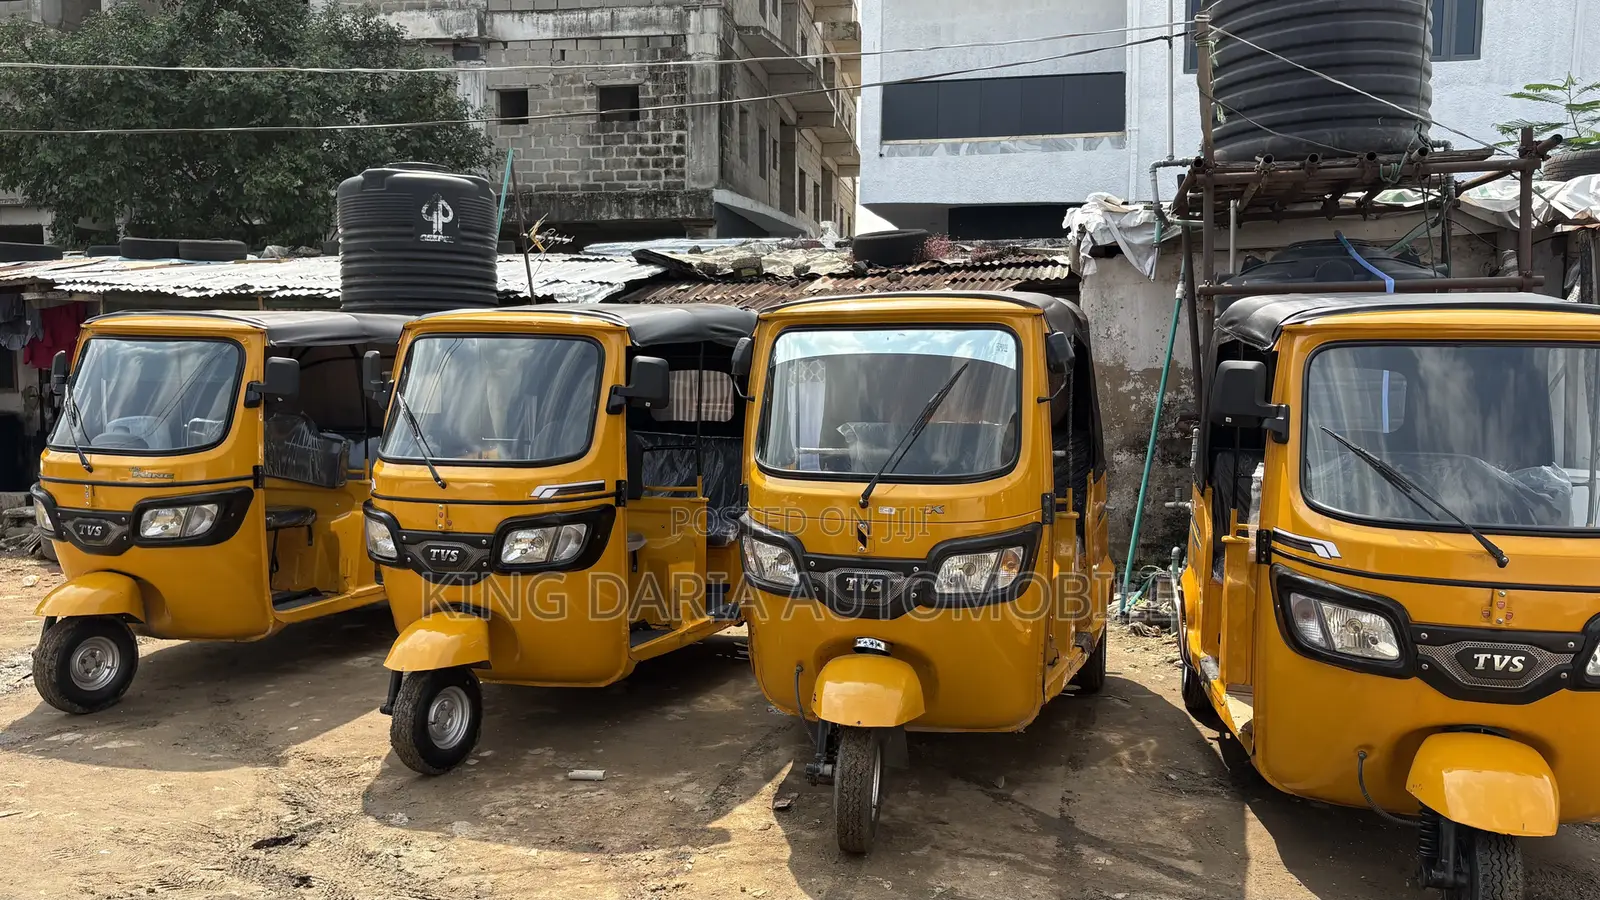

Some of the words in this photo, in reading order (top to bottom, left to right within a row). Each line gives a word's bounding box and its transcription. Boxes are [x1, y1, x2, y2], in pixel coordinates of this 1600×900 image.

[79, 524, 103, 537] TVS
[430, 548, 459, 562] TVS
[845, 577, 884, 593] TVS
[1473, 653, 1526, 673] TVS
